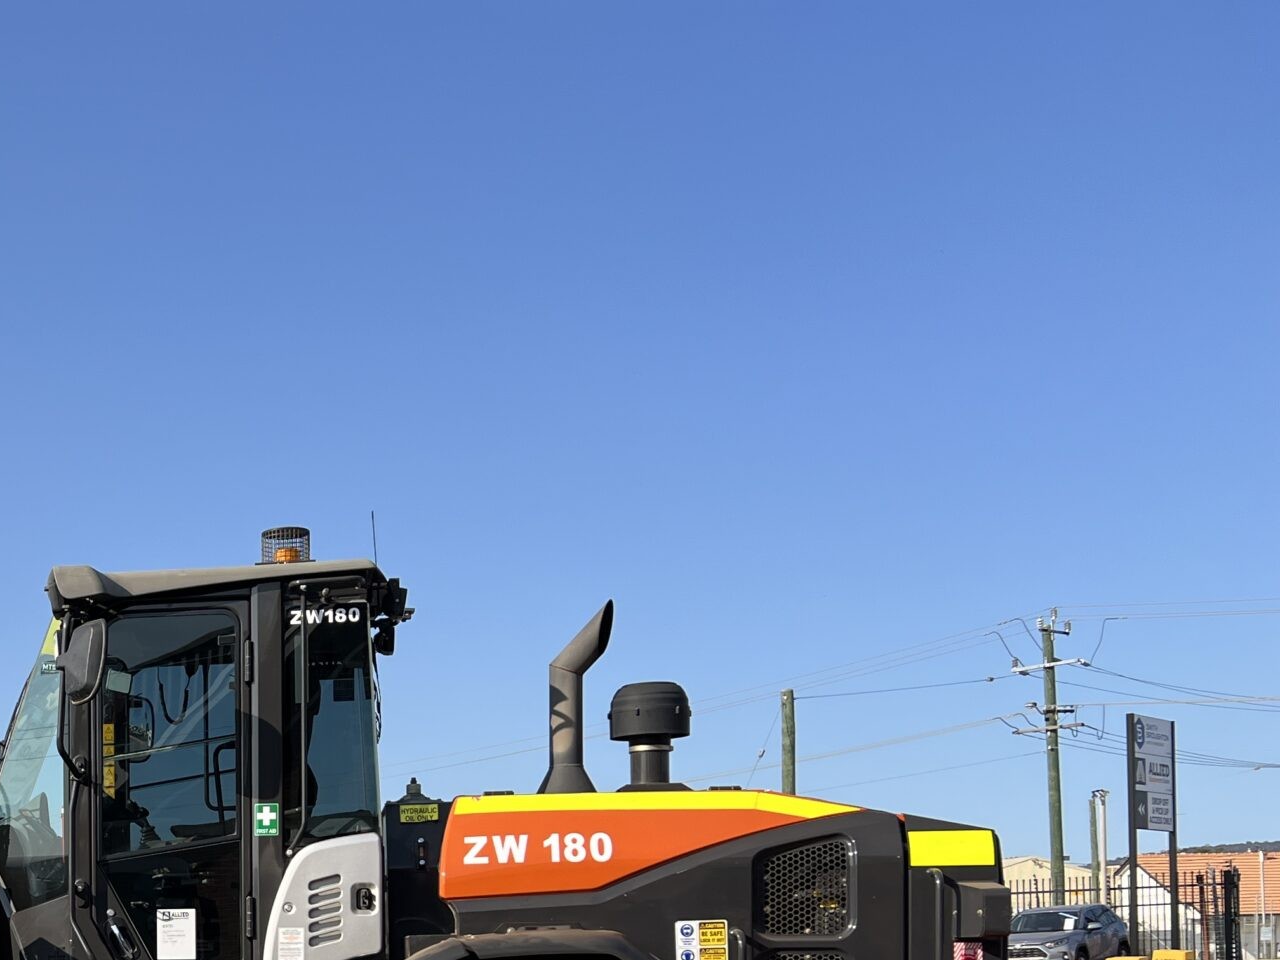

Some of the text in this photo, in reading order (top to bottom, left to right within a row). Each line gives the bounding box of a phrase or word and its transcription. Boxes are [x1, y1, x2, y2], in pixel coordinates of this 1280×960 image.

[289, 607, 360, 625] ZW180
[1149, 761, 1170, 778] ALLIED
[463, 832, 613, 865] ZW 180
